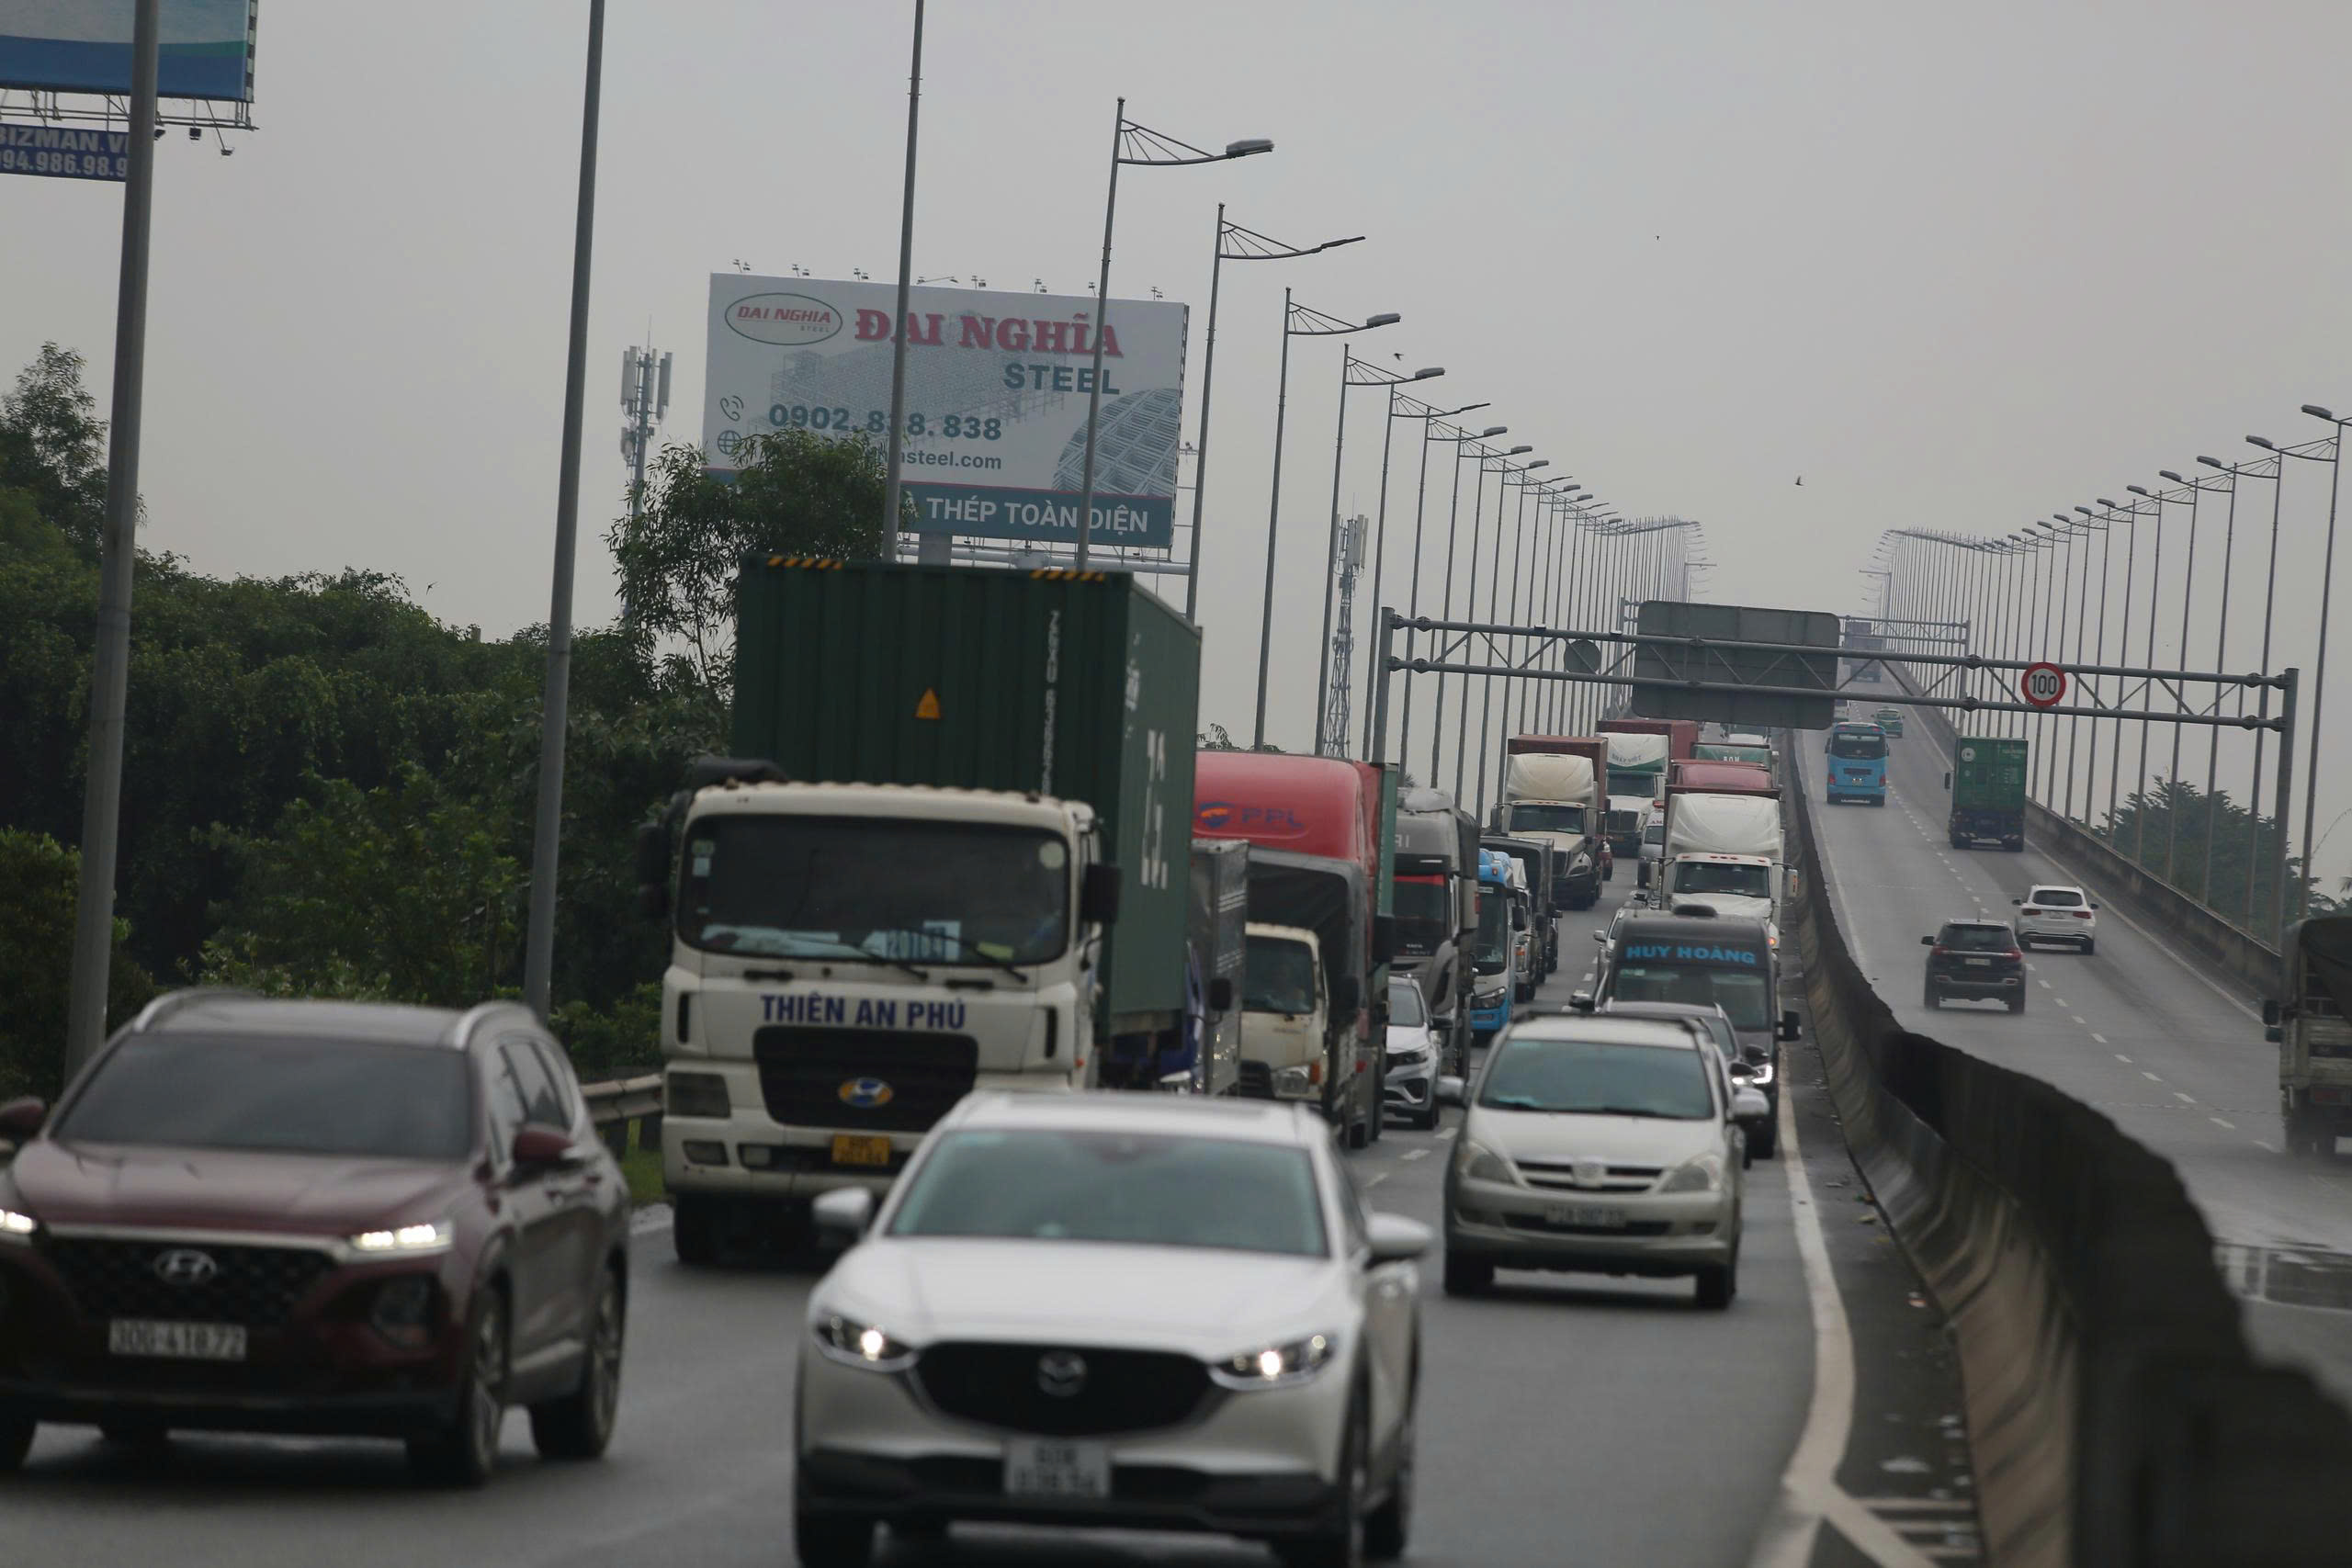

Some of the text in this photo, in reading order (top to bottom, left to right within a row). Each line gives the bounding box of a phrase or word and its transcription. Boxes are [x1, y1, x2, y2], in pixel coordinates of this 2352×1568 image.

[0, 149, 128, 177] 94.986.98.9
[958, 312, 1124, 358] NGHĨA
[1003, 363, 1120, 395] STEEL
[926, 495, 997, 523] THÉP
[1004, 500, 1078, 528] TOÀN
[1088, 504, 1148, 536] DIỆN
[2031, 674, 2057, 694] 100
[1625, 945, 1670, 959] HUY
[760, 990, 845, 1023] THIÊN
[854, 998, 897, 1027] AN
